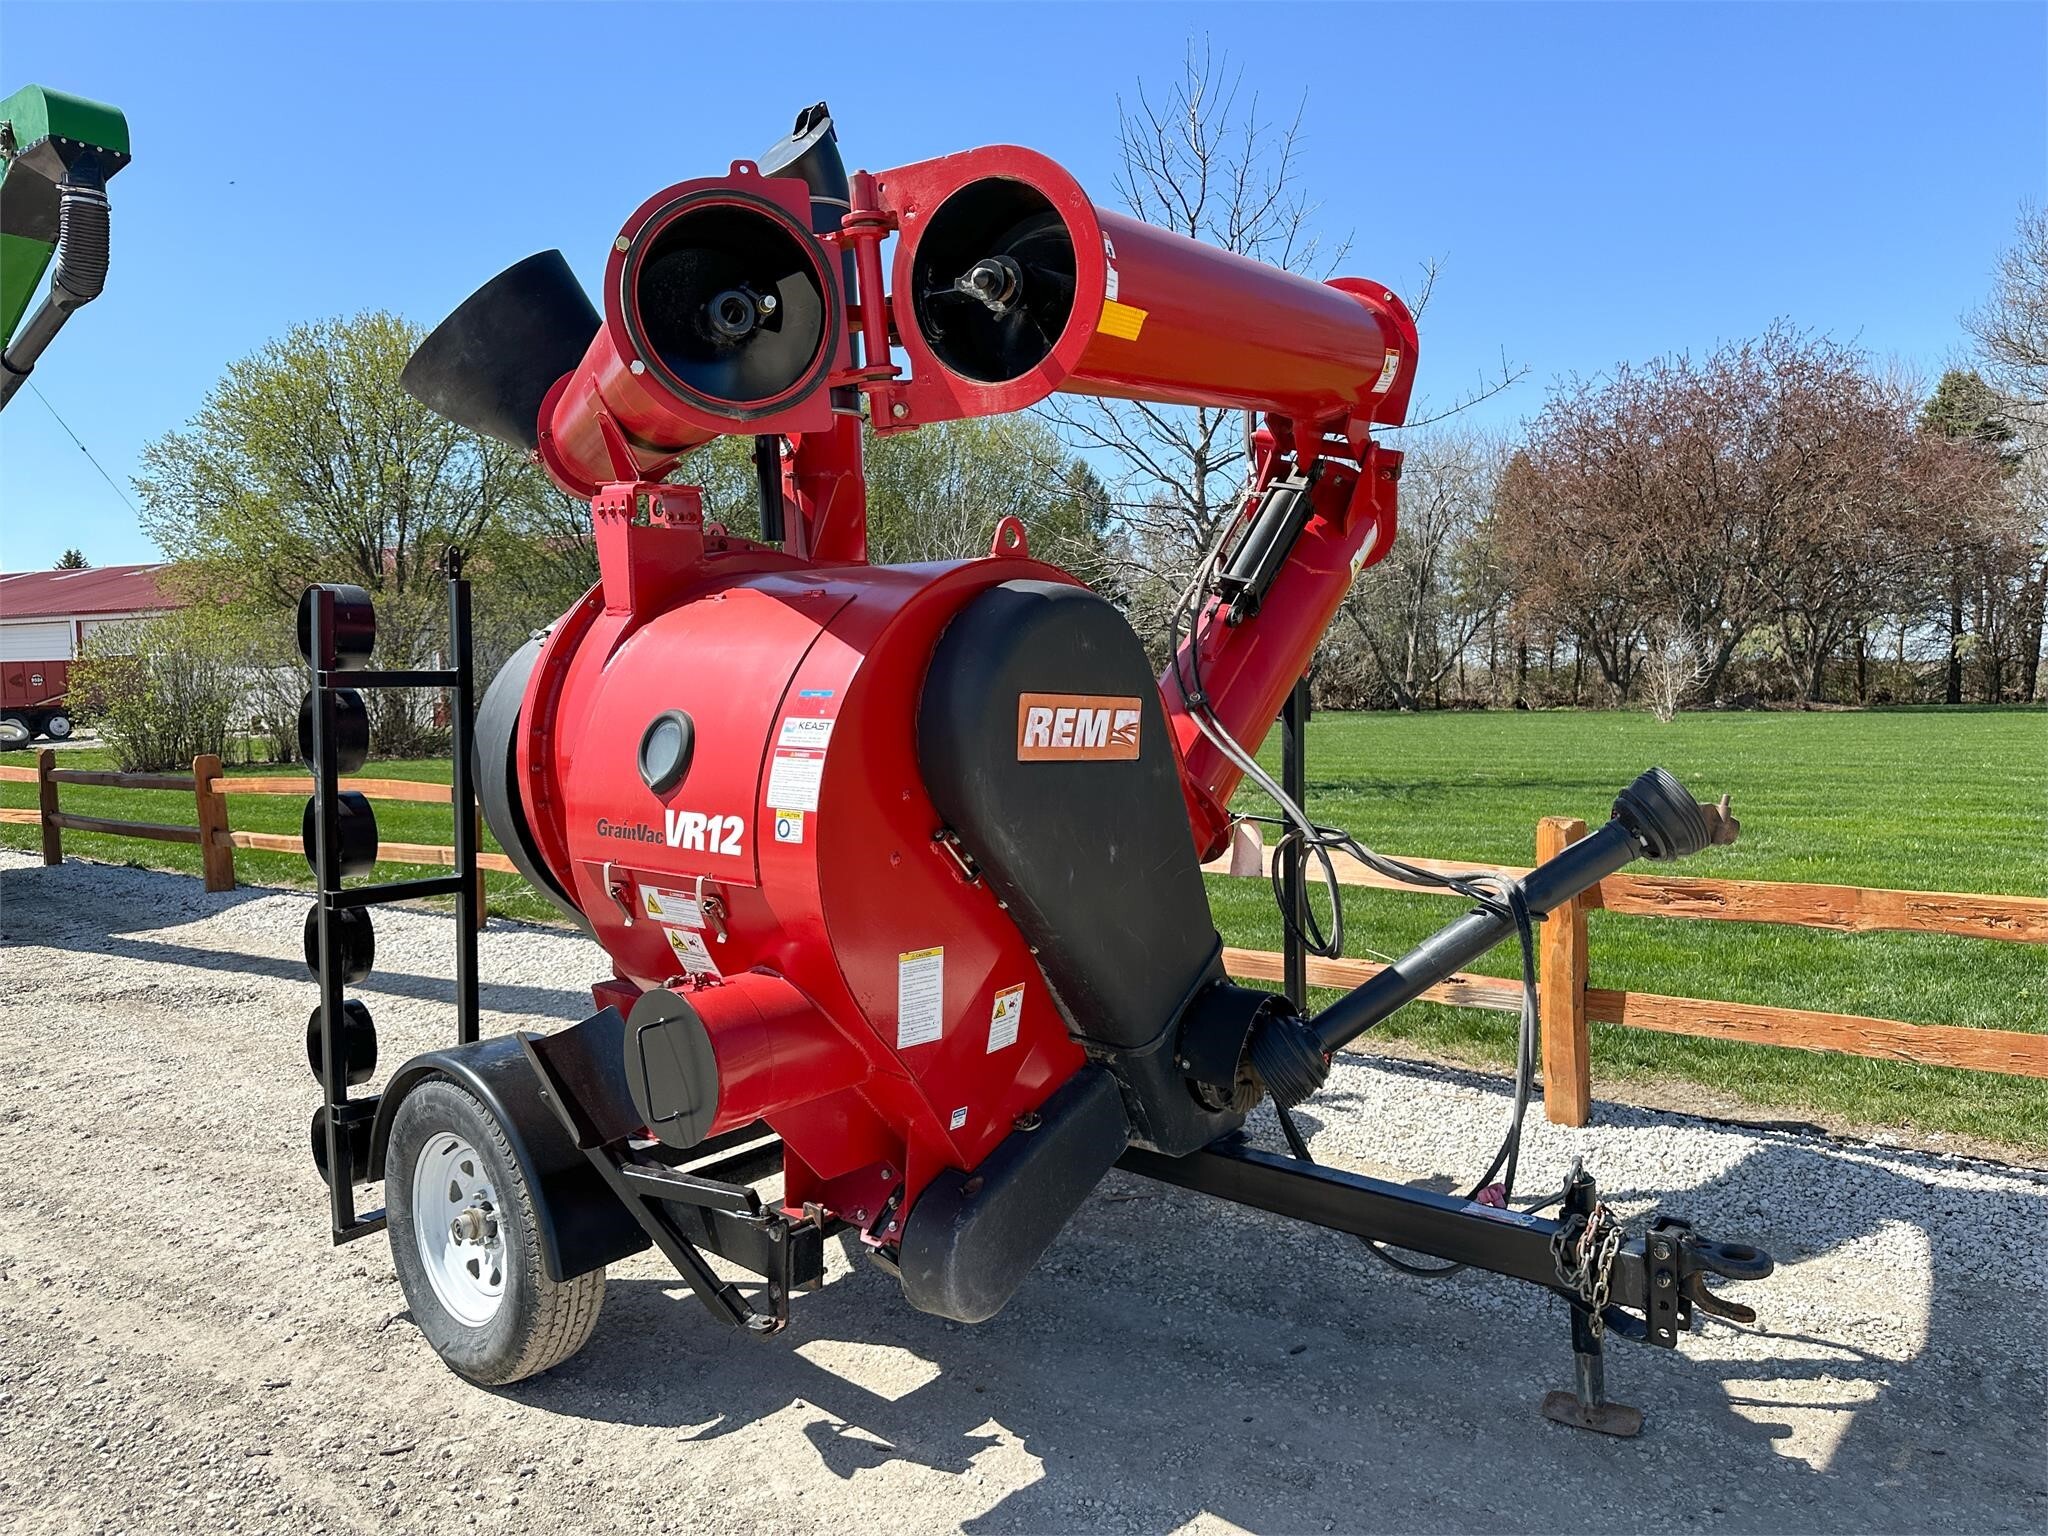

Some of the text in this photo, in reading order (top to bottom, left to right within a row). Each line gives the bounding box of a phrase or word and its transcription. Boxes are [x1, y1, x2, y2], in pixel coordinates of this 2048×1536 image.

[798, 721, 832, 731] KEAST
[1023, 707, 1111, 747] REM
[597, 809, 744, 856] GrainVac VR12
